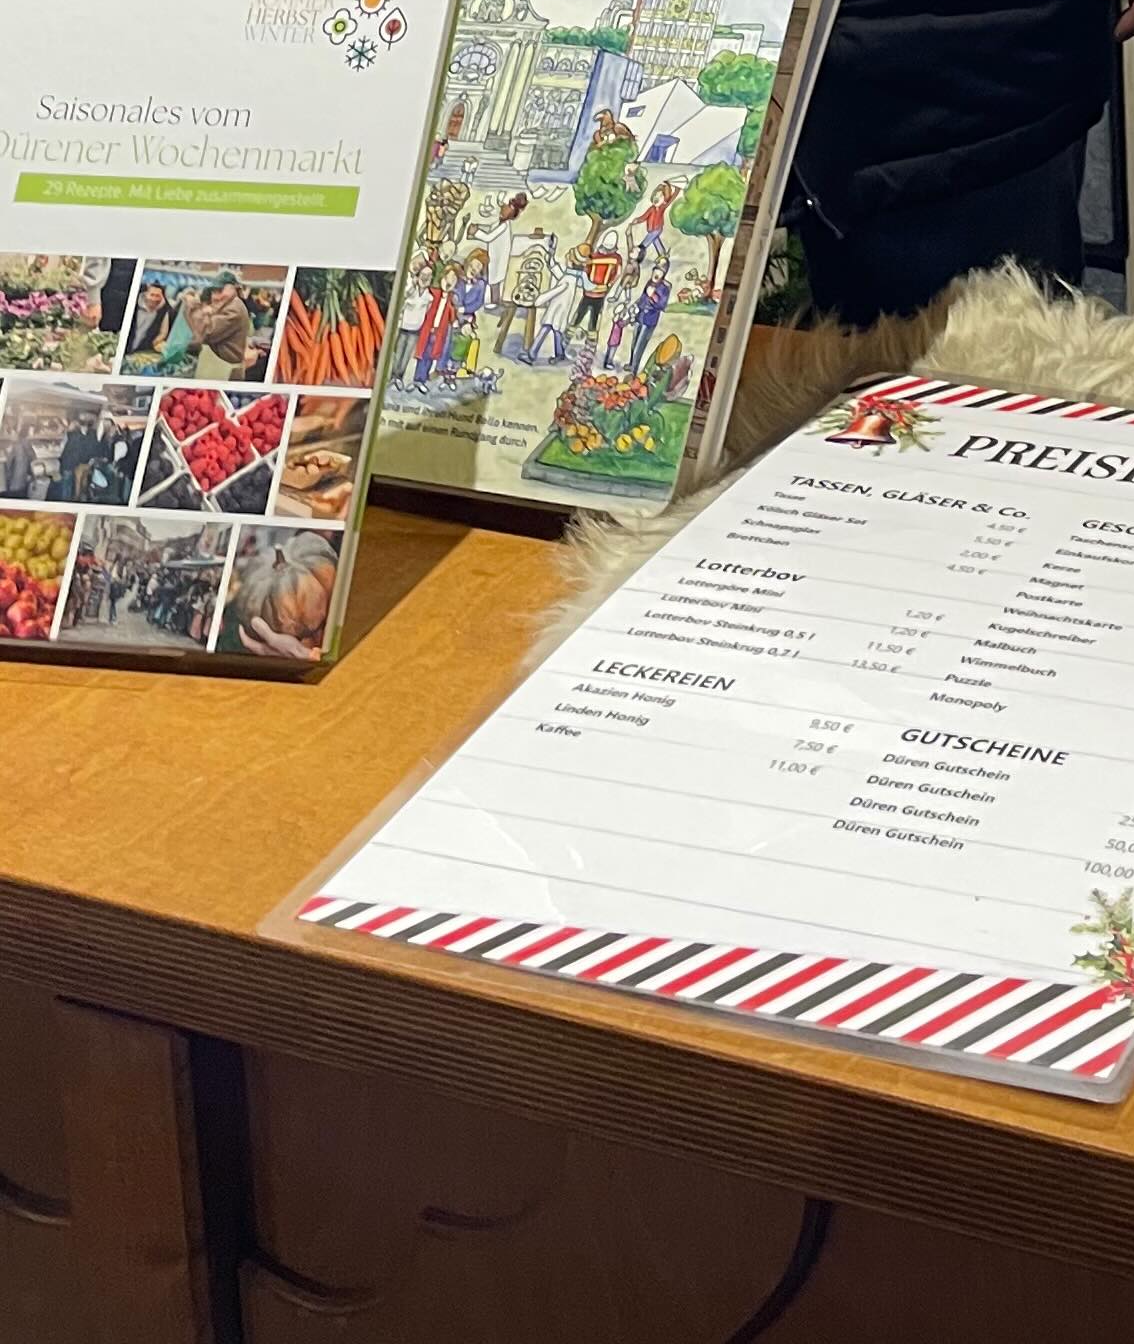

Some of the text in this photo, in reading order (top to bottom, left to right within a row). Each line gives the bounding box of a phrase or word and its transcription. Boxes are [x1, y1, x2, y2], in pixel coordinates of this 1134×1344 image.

[246, 6, 323, 26] HERBST
[244, 25, 317, 44] WINTER
[36, 94, 251, 128] Saisonales vom
[131, 134, 366, 176] Wochenmarkt
[42, 180, 64, 197] 29
[155, 186, 194, 203] Liebe
[499, 435, 528, 449] durch
[789, 475, 1031, 519] TASSEN, GLÄSER & Co.
[695, 558, 808, 583] Lotterbov
[1028, 576, 1085, 591] Magnet
[731, 603, 764, 614] Mini
[1015, 590, 1083, 608] Postkarte
[644, 609, 713, 628] Lotterbov
[715, 620, 781, 638] Steinkrug
[1003, 605, 1124, 632] Weihnachtskarte
[626, 627, 694, 646] Lotterbov
[695, 636, 766, 656] Steinkrug
[987, 622, 1098, 646] Kugelschreiber
[973, 638, 1038, 656] Malbuch
[592, 659, 736, 692] LECKEREIEN
[960, 655, 1058, 679] Wimmelbuch
[944, 672, 993, 689] Puzzle
[571, 683, 678, 708] Akazien Honig
[929, 691, 1010, 714] Monopoly
[554, 702, 651, 728] Linden Honig
[535, 722, 583, 739] Kaffee
[900, 728, 1070, 767] GUTSCHEINE
[882, 752, 1012, 783] Düren Gutschein
[865, 774, 997, 805] Düren Gutschein
[848, 796, 981, 828] Düren Gutschein
[831, 818, 965, 852] Düren Gutschein
